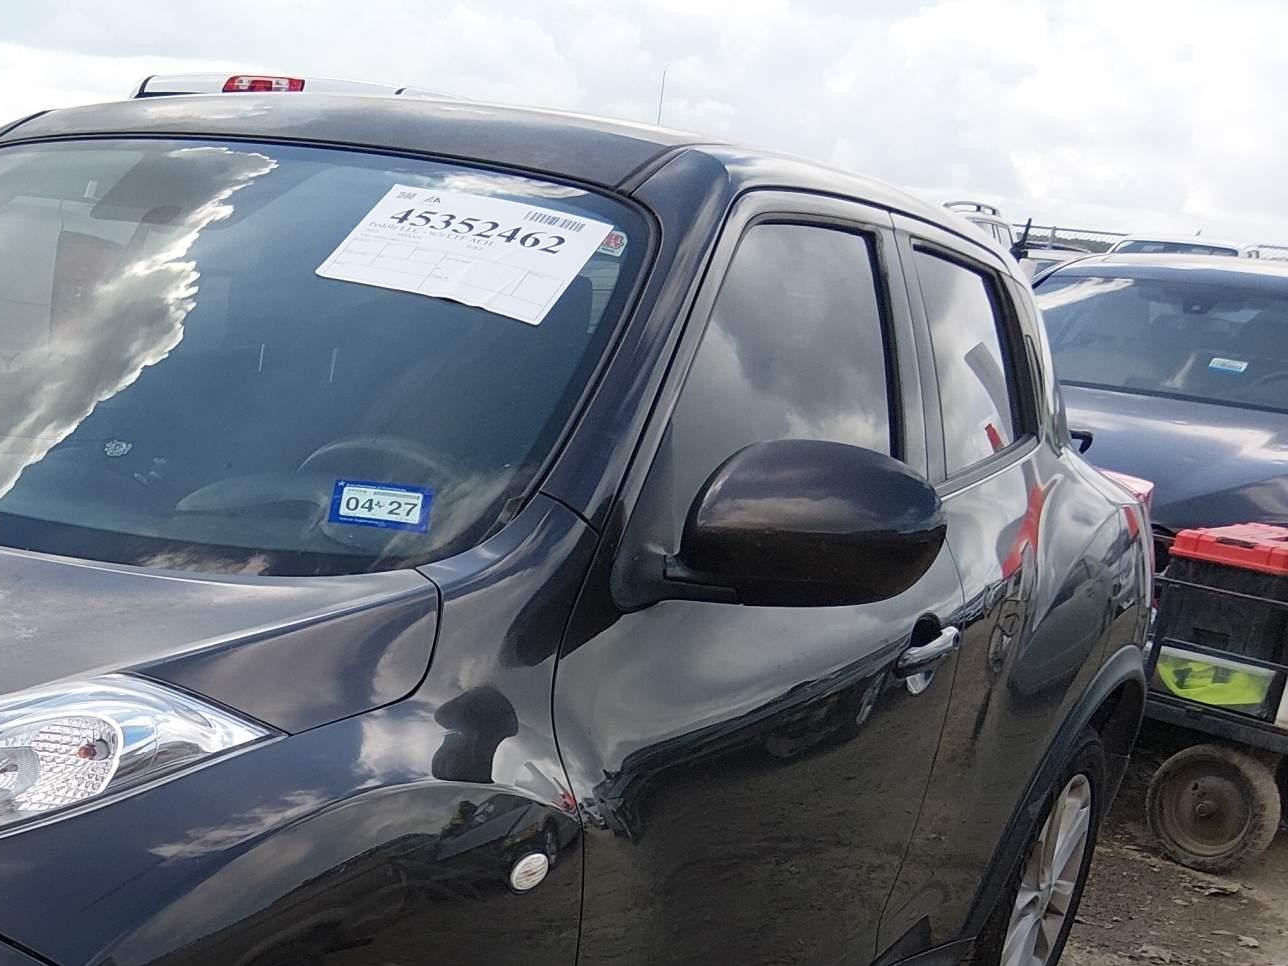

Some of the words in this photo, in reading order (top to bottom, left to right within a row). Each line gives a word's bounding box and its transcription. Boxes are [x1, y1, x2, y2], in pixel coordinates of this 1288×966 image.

[389, 208, 566, 254] 45352462
[345, 496, 374, 513] 04
[387, 500, 418, 517] 27
